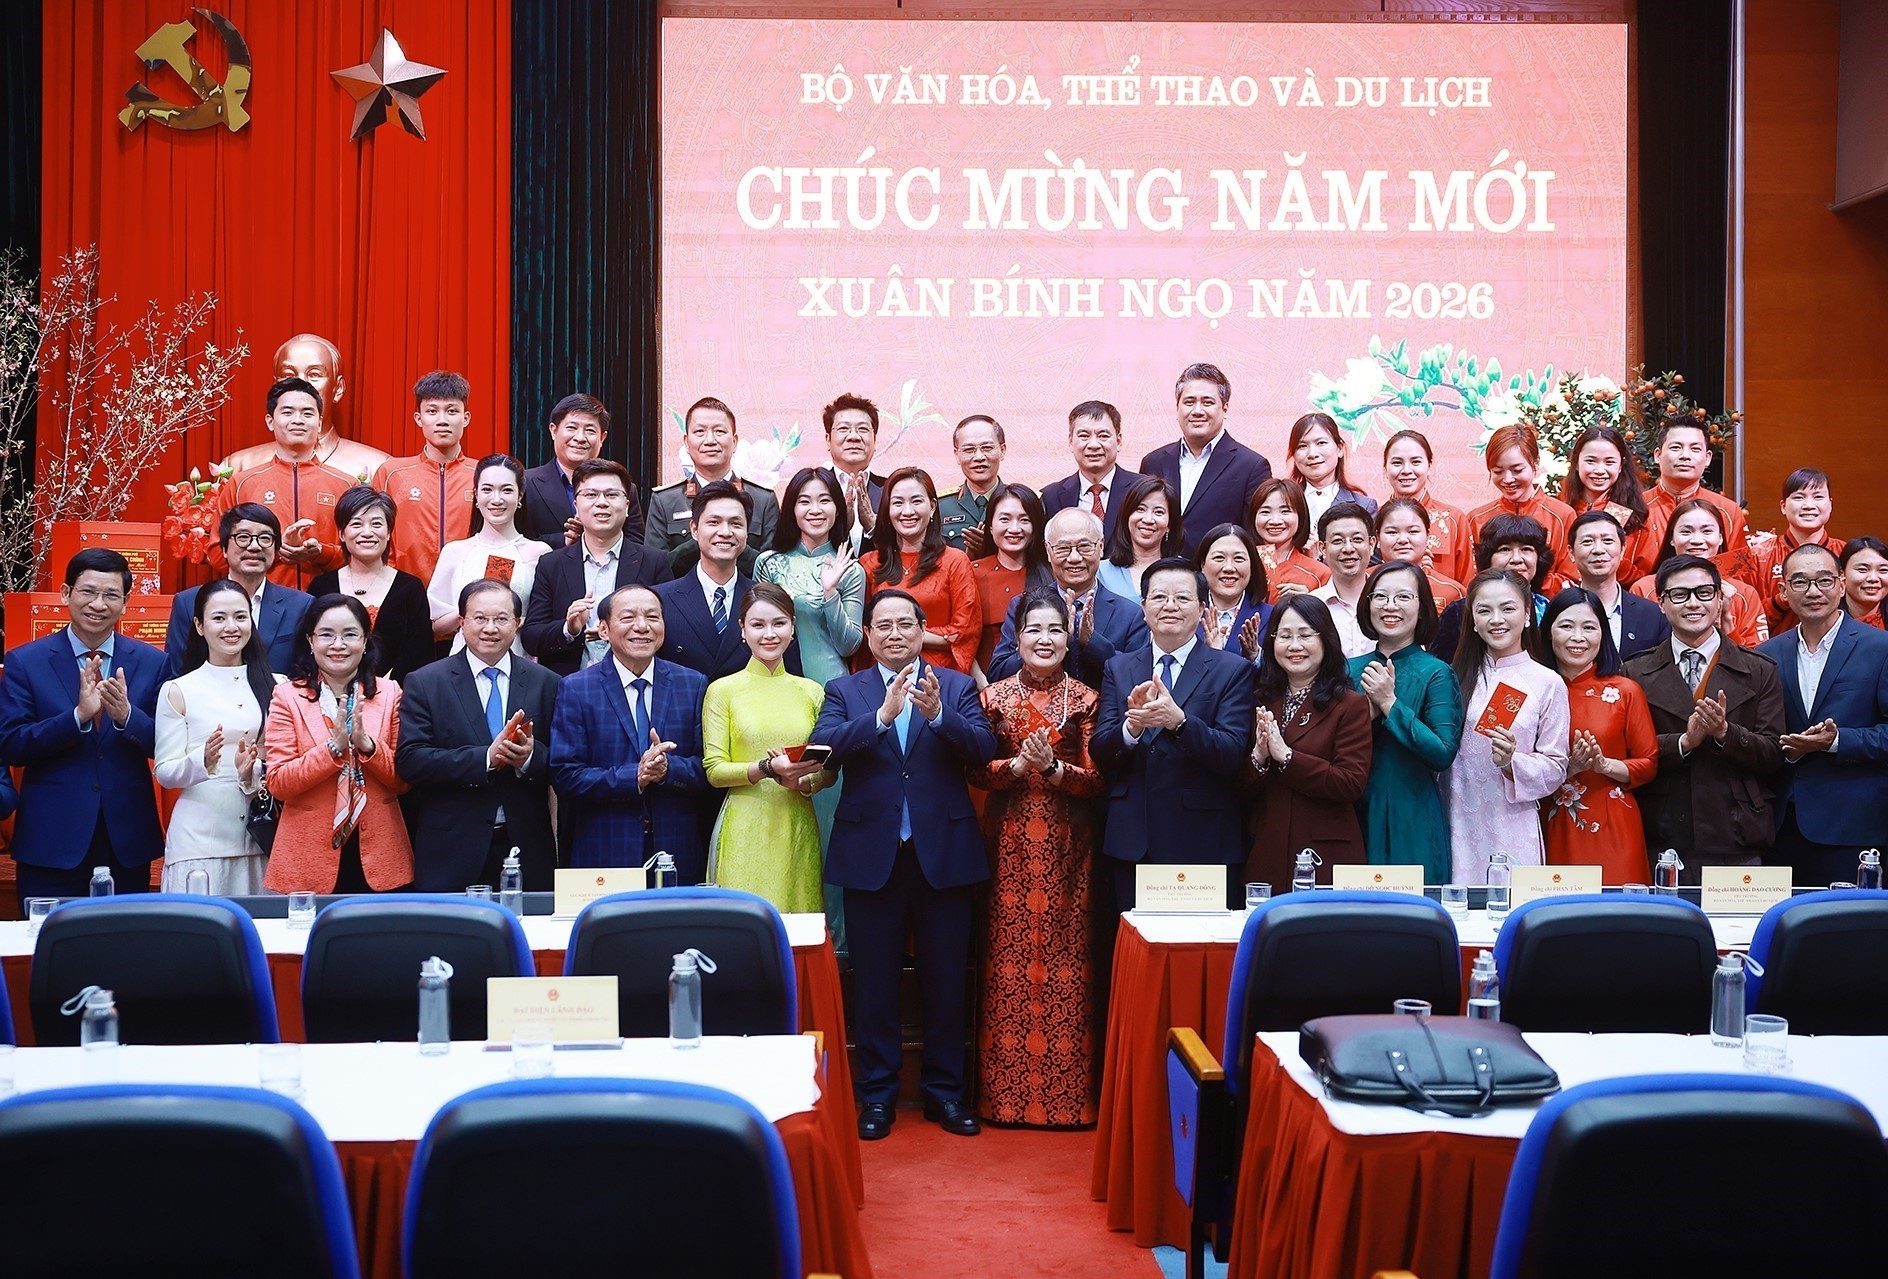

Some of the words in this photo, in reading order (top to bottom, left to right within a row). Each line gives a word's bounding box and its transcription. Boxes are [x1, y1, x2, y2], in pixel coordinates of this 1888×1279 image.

[800, 64, 855, 113] BỘ
[864, 66, 950, 106] VĂN
[960, 65, 1053, 112] HÓA,
[1063, 55, 1142, 107] THỂ
[1151, 75, 1260, 108] THAO
[1269, 68, 1326, 108] VÀ
[1335, 77, 1391, 109] DU
[1401, 77, 1493, 116] LỊCH
[736, 146, 942, 233] CHÚC
[963, 149, 1191, 234] MỪNG
[1210, 151, 1390, 233] NĂM
[1409, 148, 1557, 234] MỚI
[798, 264, 956, 320] XUÂN
[965, 264, 1106, 320] BÍNH
[1119, 278, 1235, 331] NGỌ
[1248, 268, 1373, 321] NĂM
[1385, 282, 1496, 321] 2026
